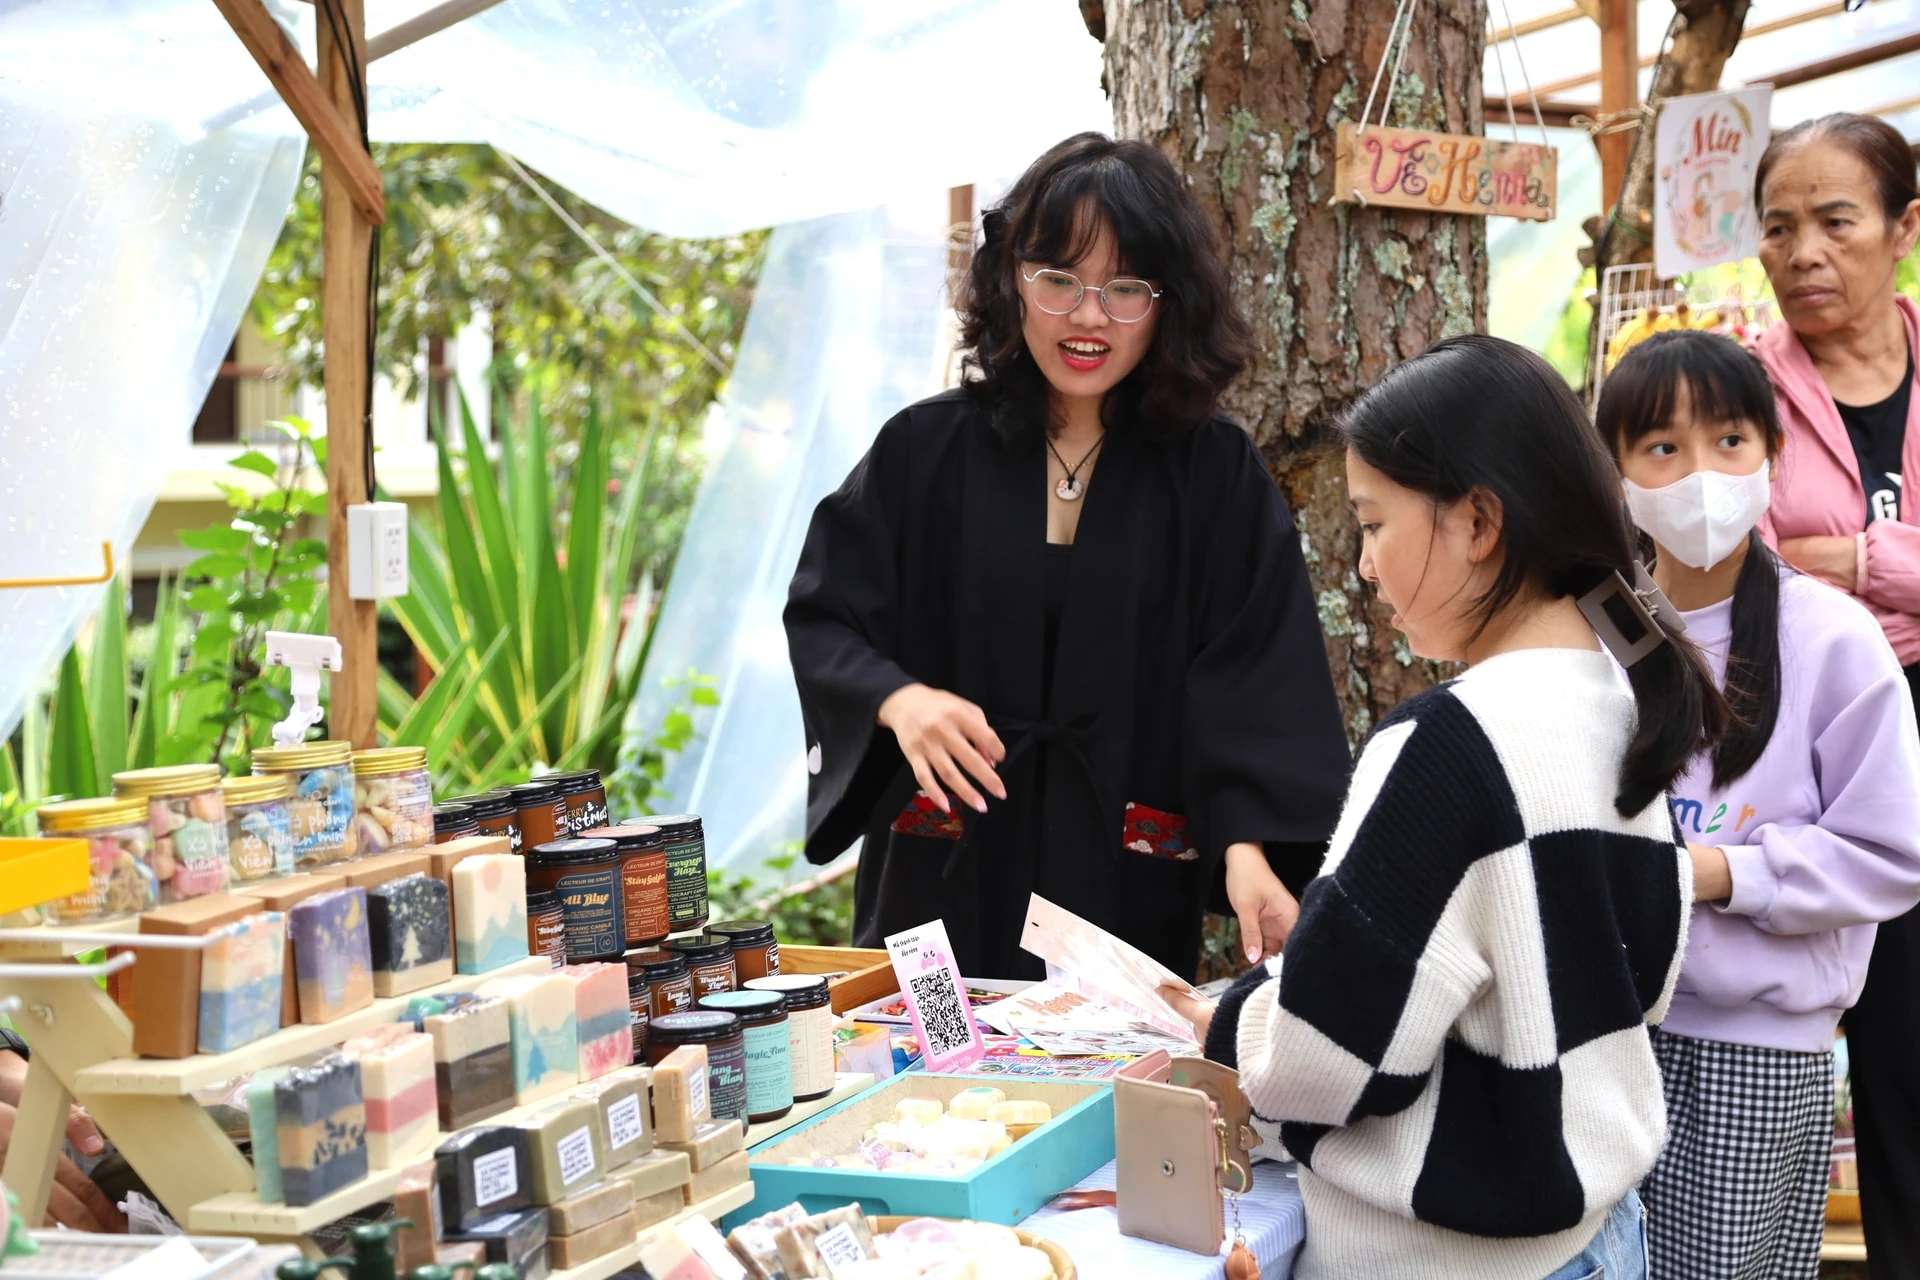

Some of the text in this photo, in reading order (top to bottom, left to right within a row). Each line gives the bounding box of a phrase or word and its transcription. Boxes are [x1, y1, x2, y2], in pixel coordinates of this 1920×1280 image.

[1682, 111, 1743, 165] Min
[1427, 140, 1549, 208] Henna
[567, 807, 585, 819] ERRY
[665, 849, 684, 857] ECTEUR
[562, 892, 610, 907] All Blue
[747, 1079, 768, 1087] RGANIC
